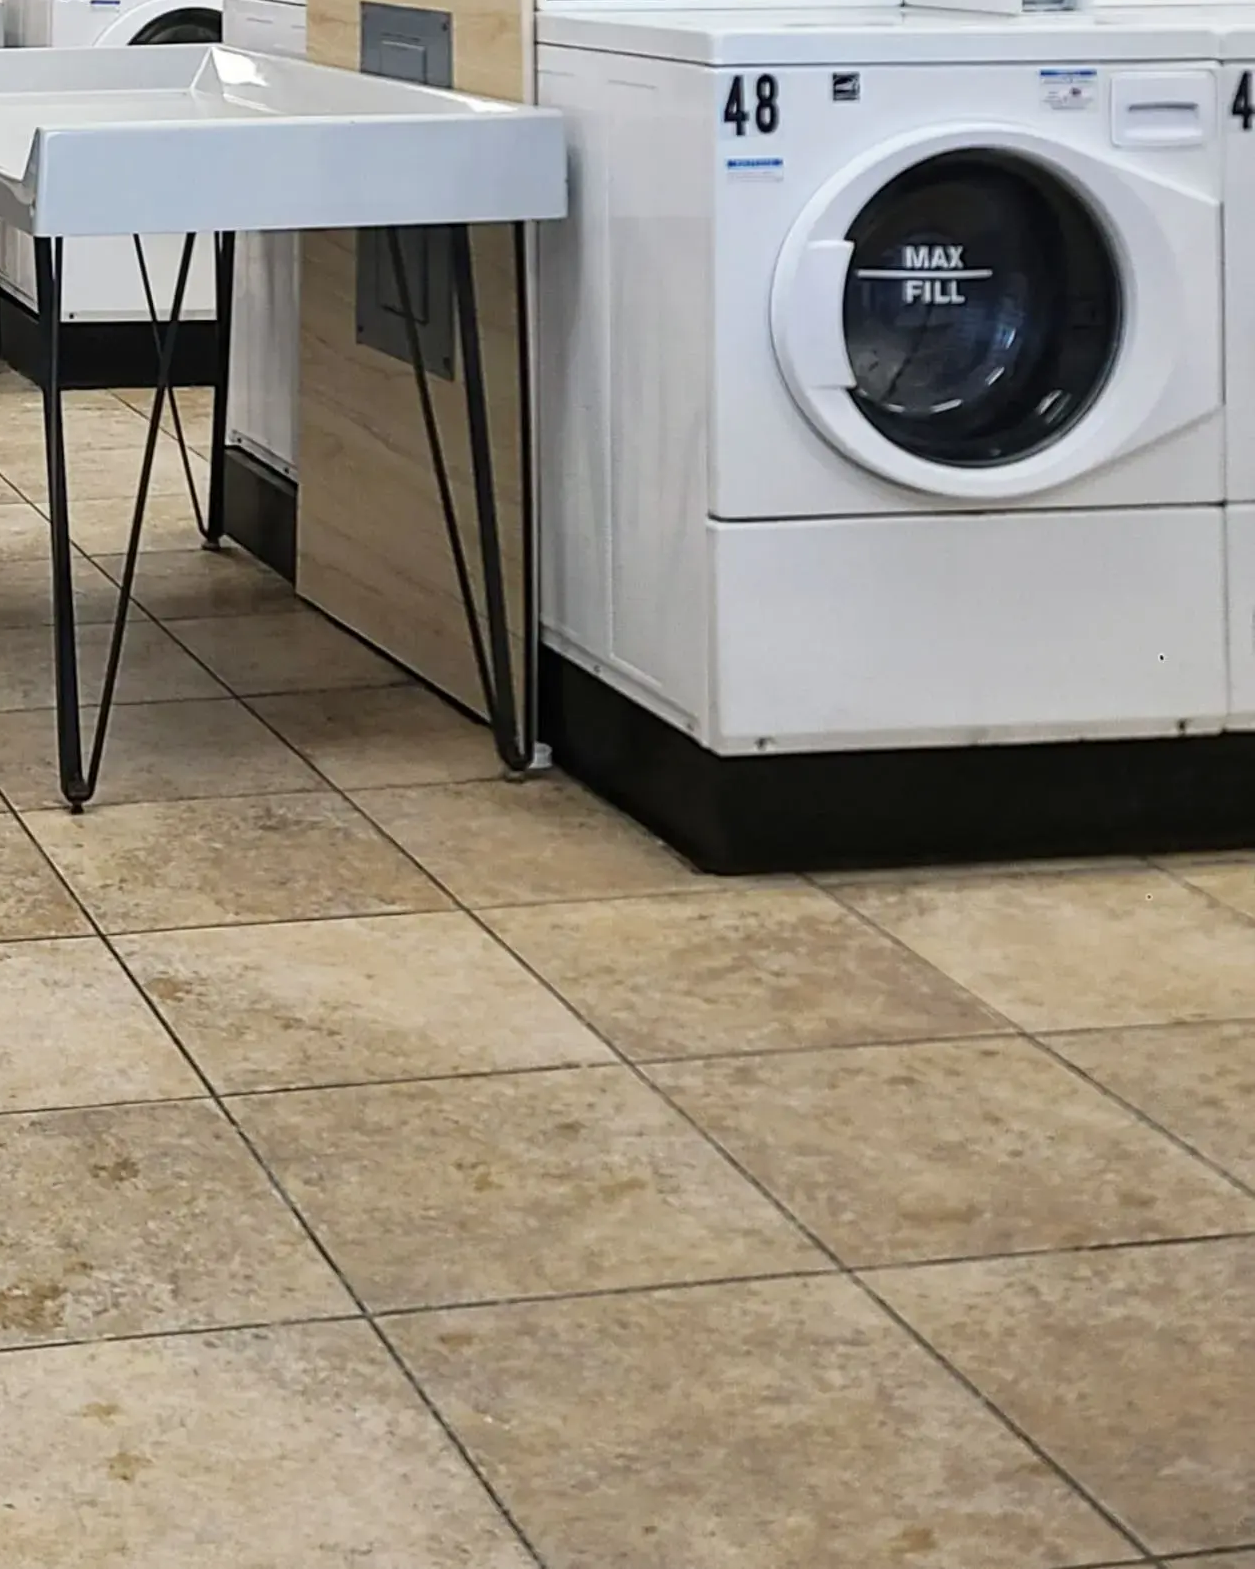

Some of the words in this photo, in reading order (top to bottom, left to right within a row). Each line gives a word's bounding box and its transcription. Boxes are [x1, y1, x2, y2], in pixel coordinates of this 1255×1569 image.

[724, 73, 779, 137] 48
[903, 244, 965, 269] MAX
[903, 279, 966, 305] FILL
